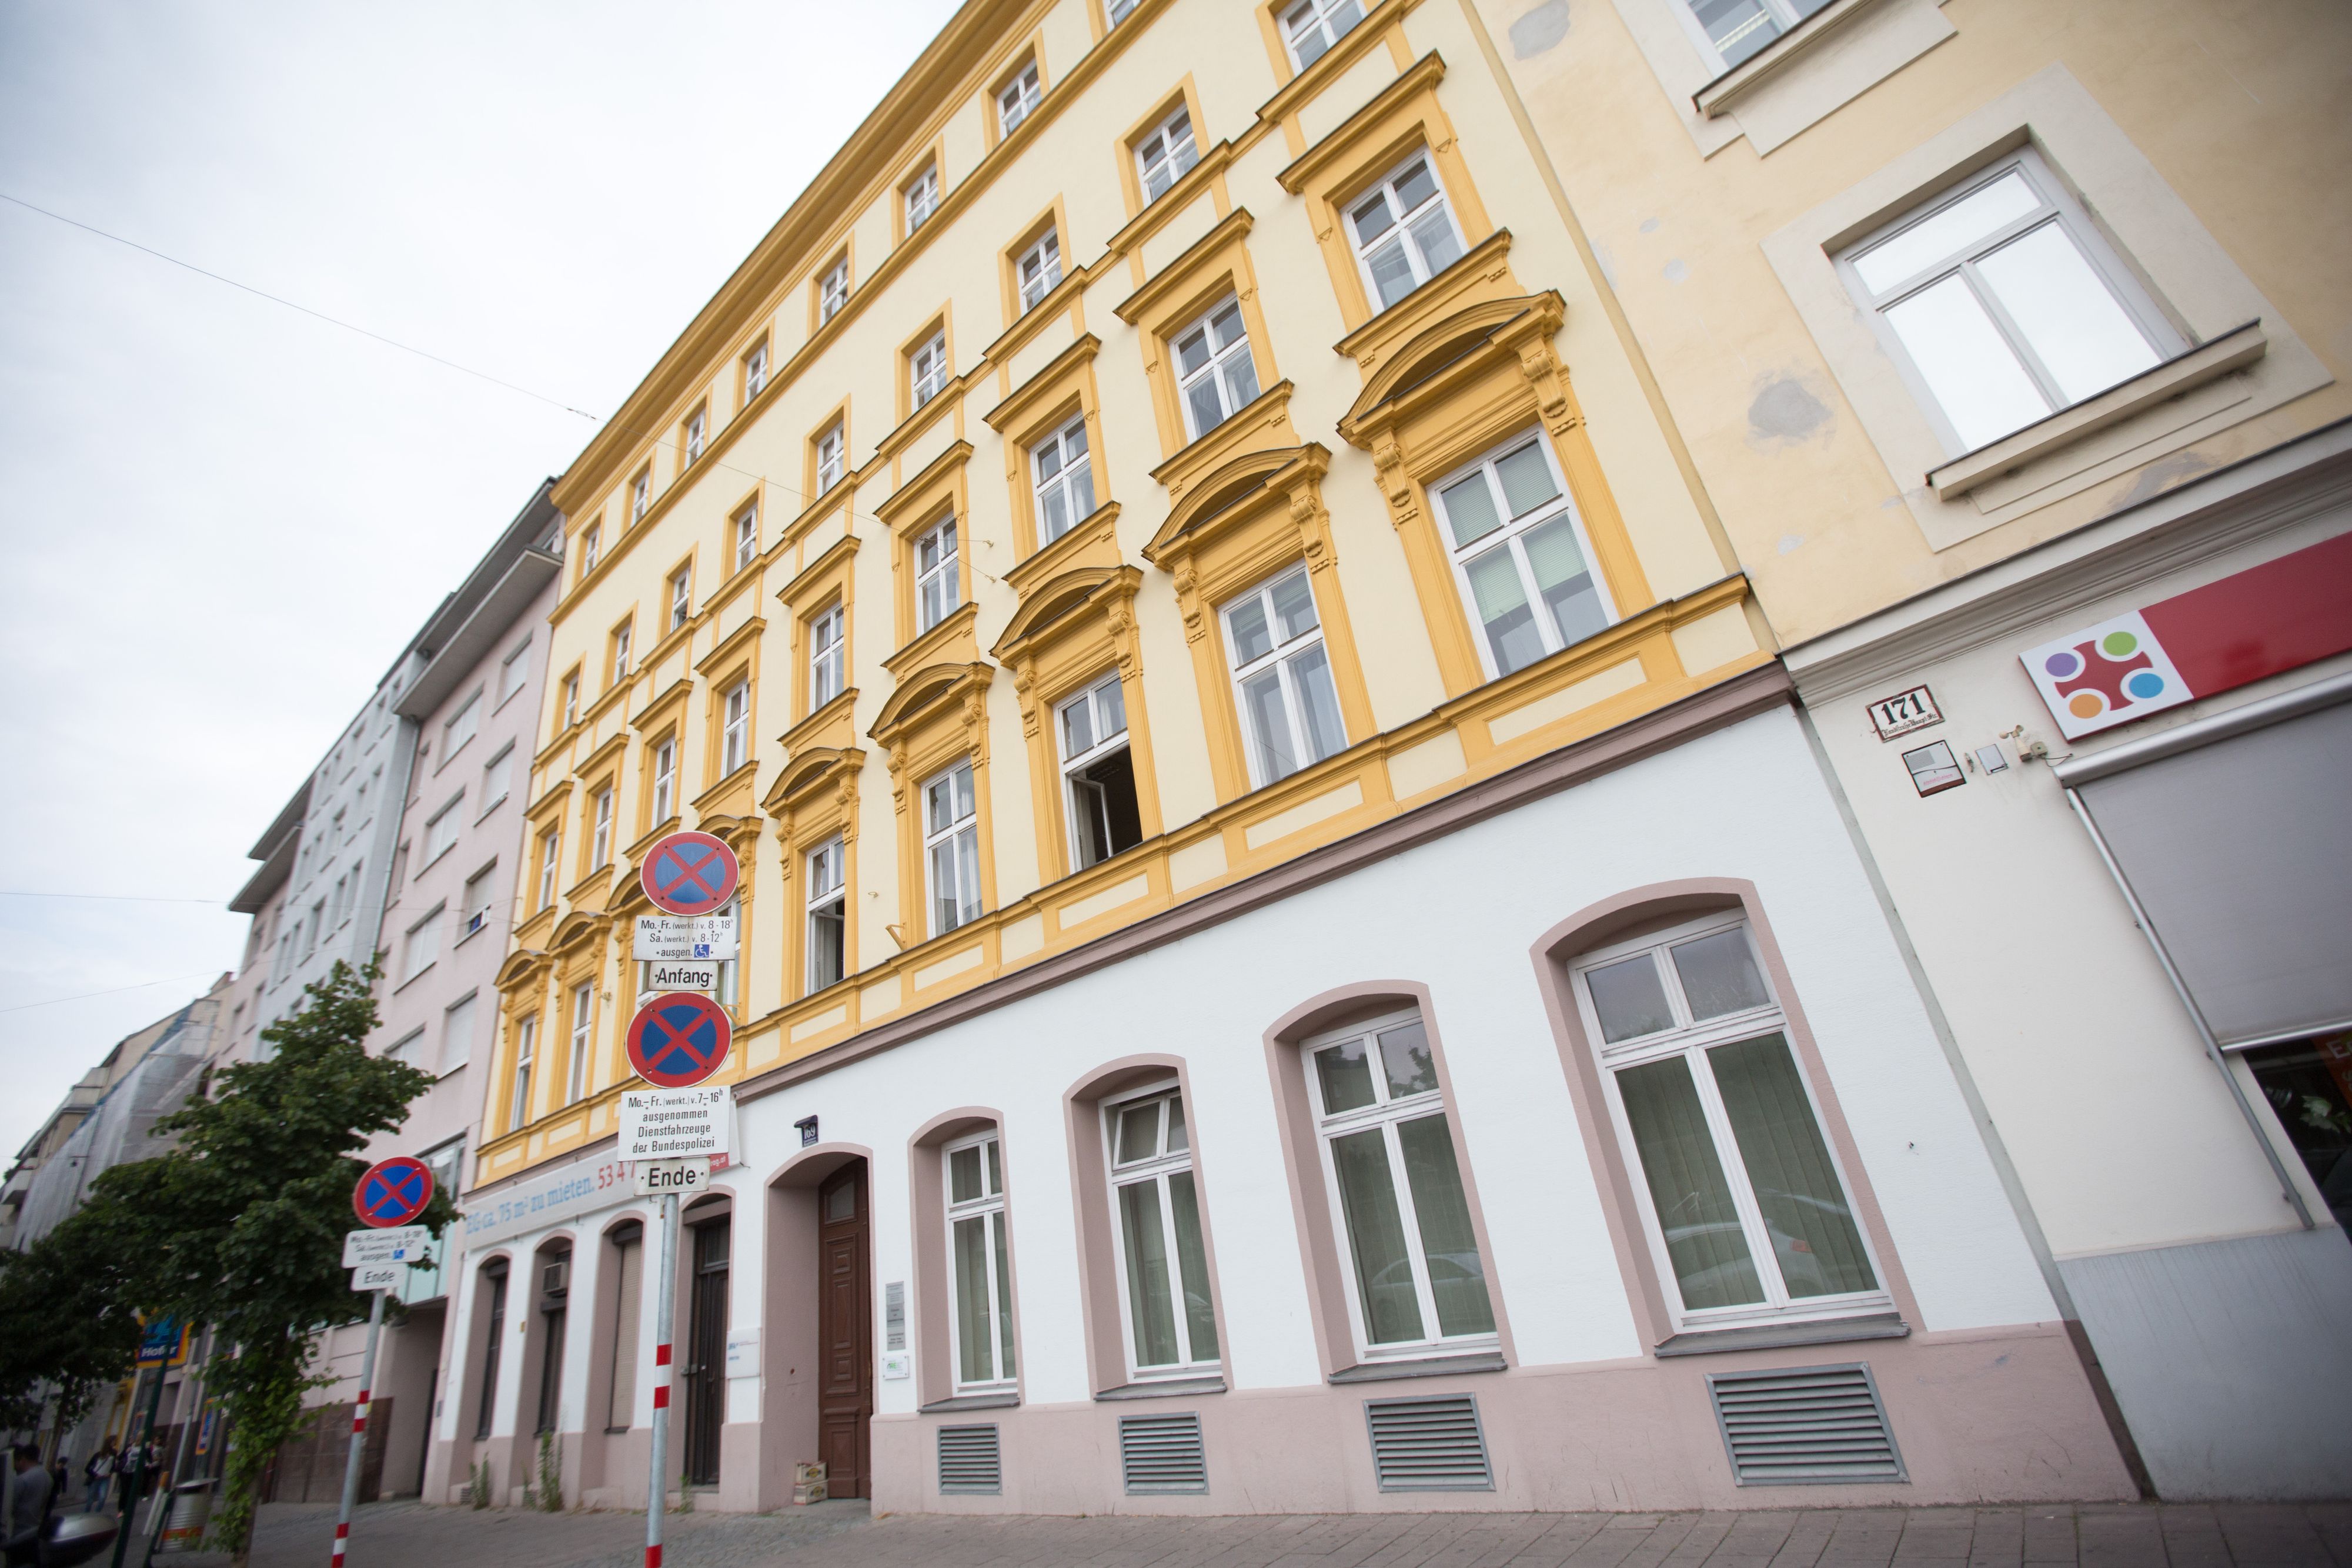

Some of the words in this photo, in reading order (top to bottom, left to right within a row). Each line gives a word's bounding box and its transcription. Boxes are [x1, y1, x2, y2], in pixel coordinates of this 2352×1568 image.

[1881, 693, 1926, 726] 171
[650, 933, 663, 943] Sa.
[661, 948, 692, 958] ausgen.
[656, 968, 710, 987] Anfang
[643, 1110, 707, 1123] ausgenommen
[638, 1124, 710, 1138] Dienstfahrzeuge
[633, 1142, 647, 1153] der
[652, 1136, 714, 1152] Bundespolizei
[710, 1155, 726, 1167] rag.at
[649, 1166, 696, 1187] Ende
[499, 1201, 512, 1223] 75
[531, 1193, 544, 1212] zu
[547, 1177, 594, 1208] mieten.
[363, 1270, 396, 1284] Ende
[141, 1345, 179, 1358] Hofr
